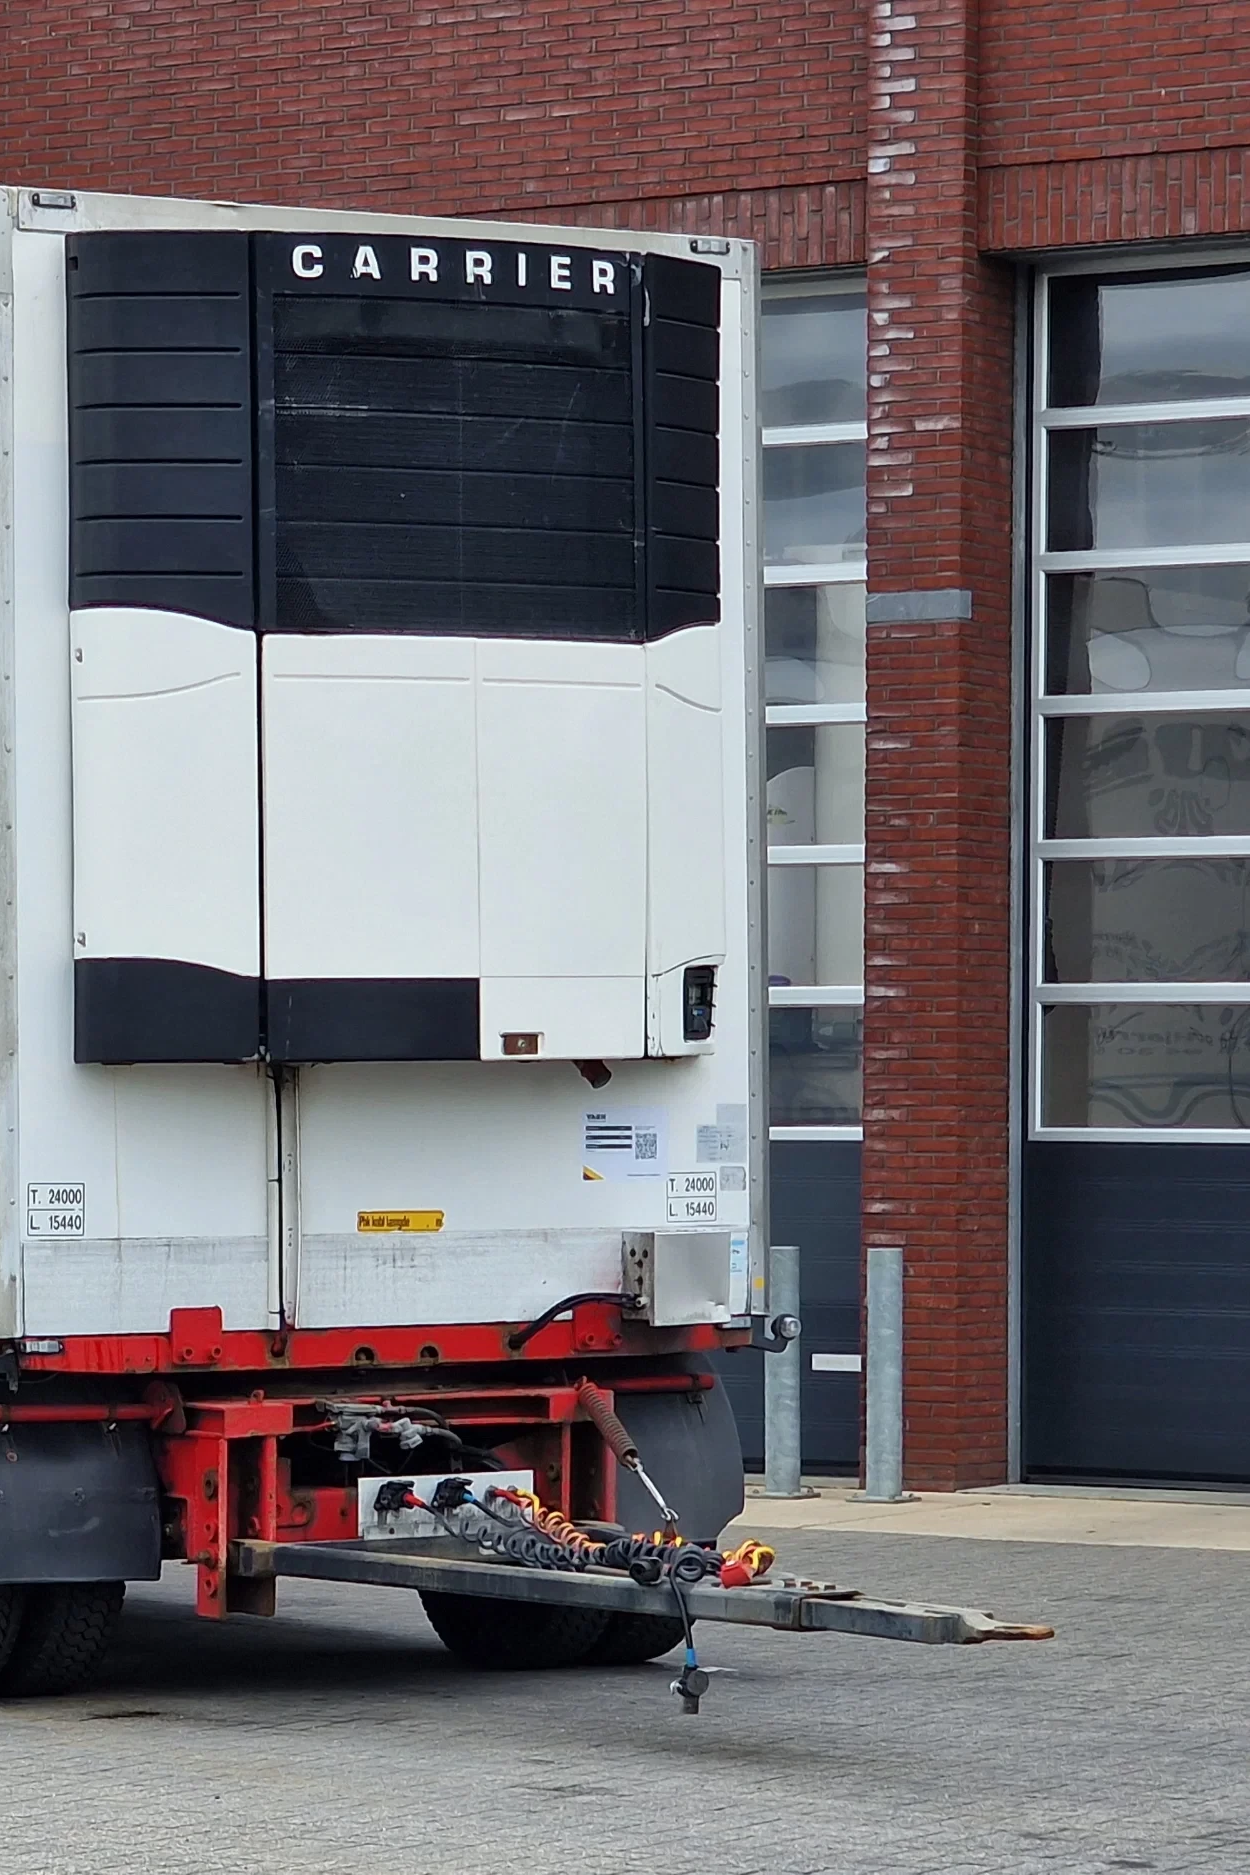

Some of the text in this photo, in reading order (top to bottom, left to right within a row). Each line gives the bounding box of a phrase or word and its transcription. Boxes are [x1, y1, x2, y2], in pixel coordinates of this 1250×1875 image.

[291, 244, 616, 295] CARRIER
[669, 1179, 679, 1193] T.
[684, 1177, 715, 1192] 24000
[30, 1188, 82, 1205] T. 24000
[669, 1201, 715, 1217] L. 15440
[48, 1214, 82, 1231] 15440
